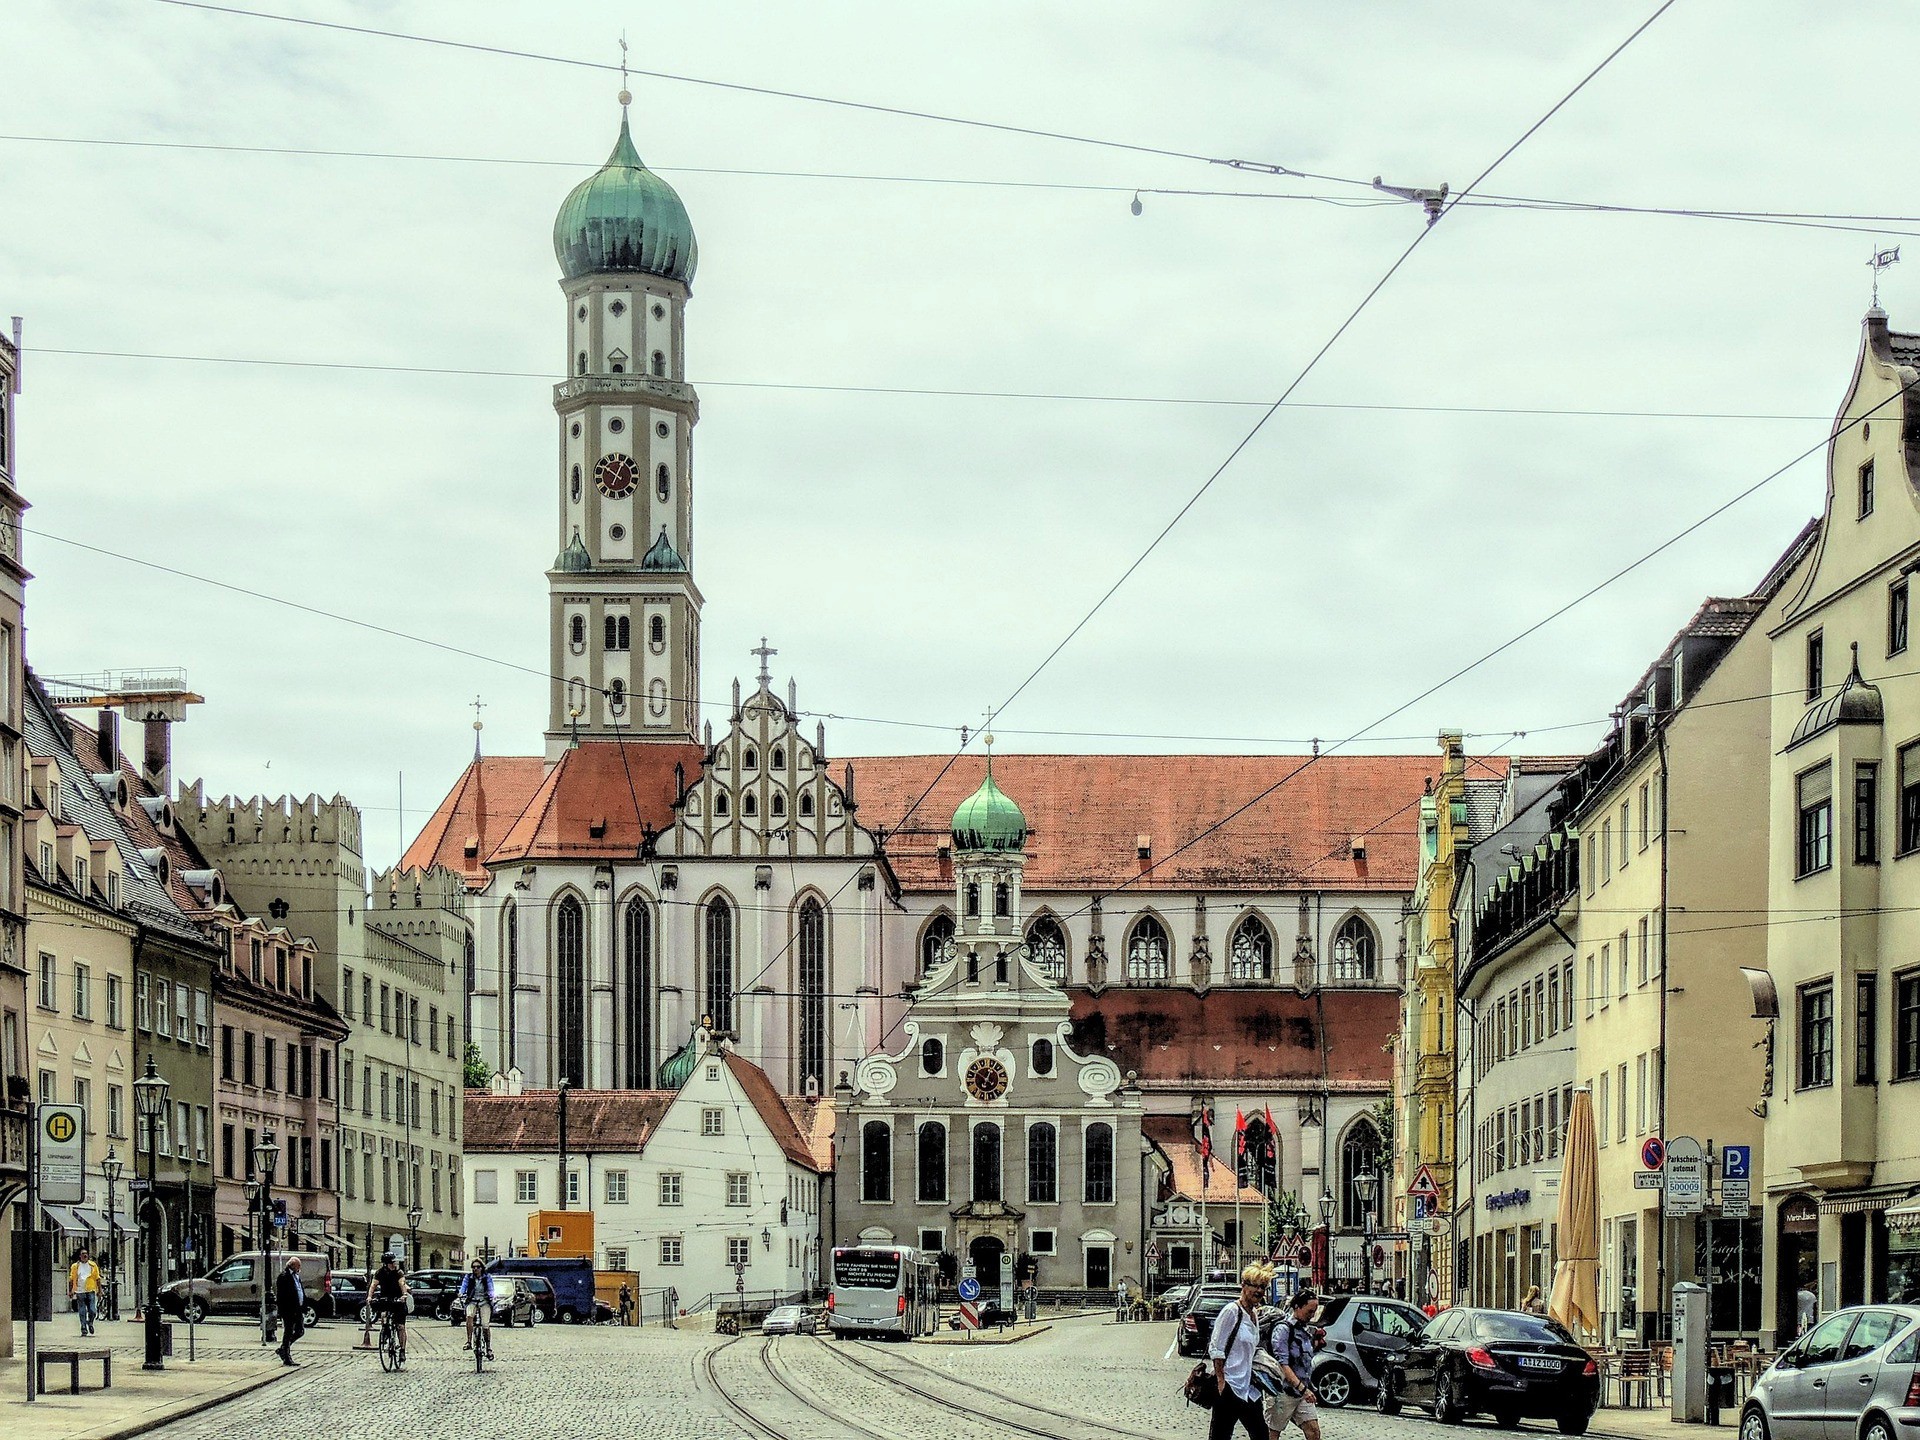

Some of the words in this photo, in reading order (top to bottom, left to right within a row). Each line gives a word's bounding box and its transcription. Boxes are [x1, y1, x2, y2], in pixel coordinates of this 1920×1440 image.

[54, 696, 87, 704] HERR
[54, 1118, 68, 1136] H
[1725, 1149, 1742, 1176] P
